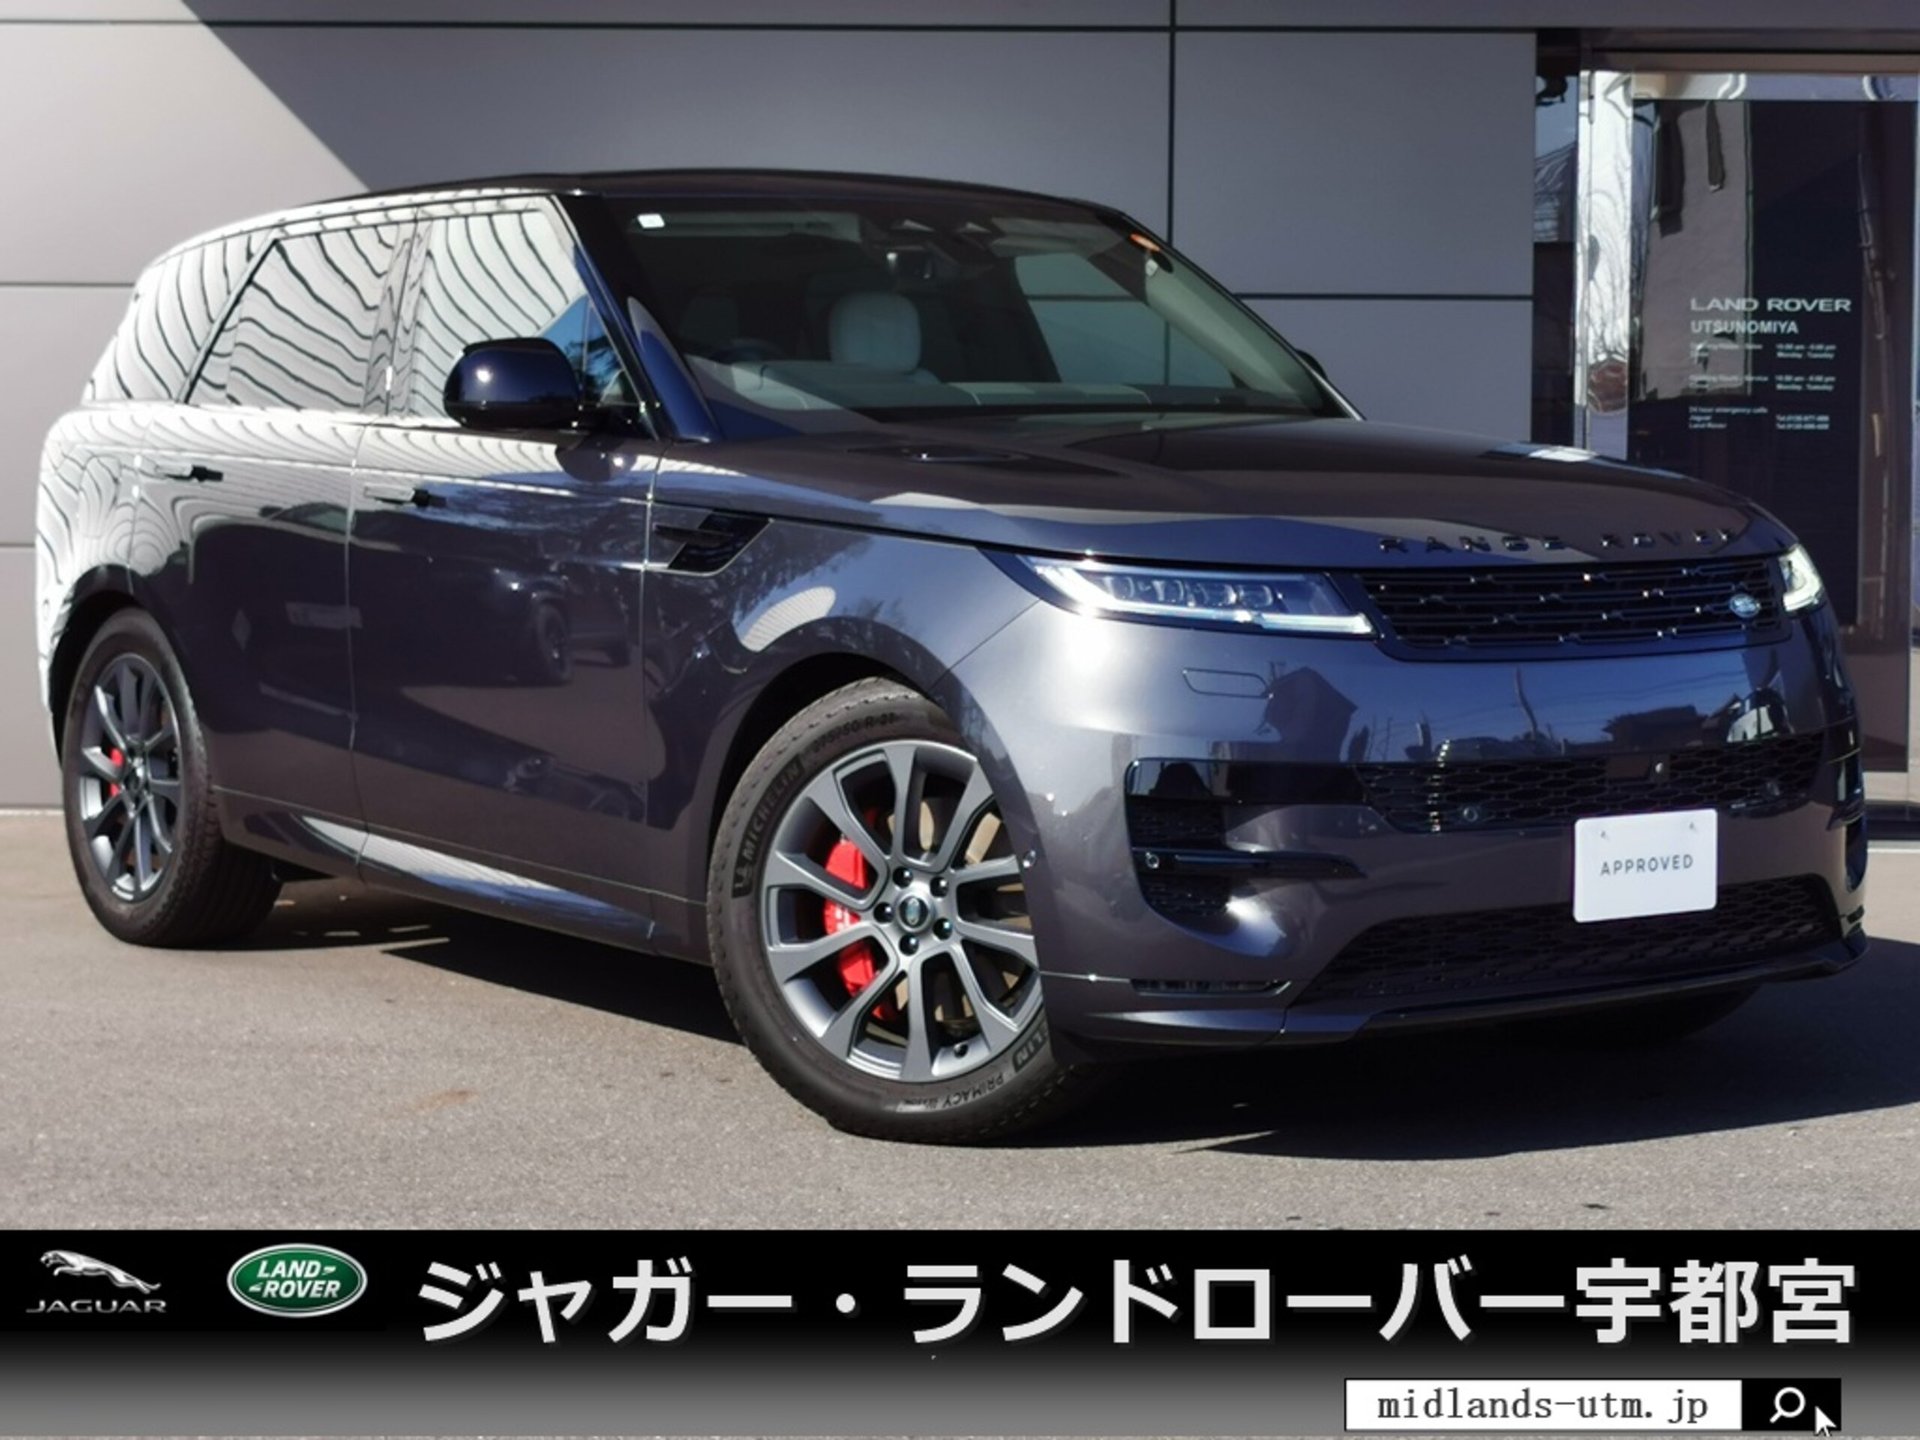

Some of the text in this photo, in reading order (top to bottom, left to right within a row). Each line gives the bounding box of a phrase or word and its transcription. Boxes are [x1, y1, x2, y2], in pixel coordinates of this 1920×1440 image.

[1690, 298, 1852, 313] LAND ROVER
[1690, 320, 1799, 334] UTSUNOMIYA
[1379, 535, 1566, 553] RANGE
[741, 761, 801, 862] MICHELIN
[1600, 854, 1694, 877] APPROVED
[943, 1074, 1004, 1106] PRIMACY
